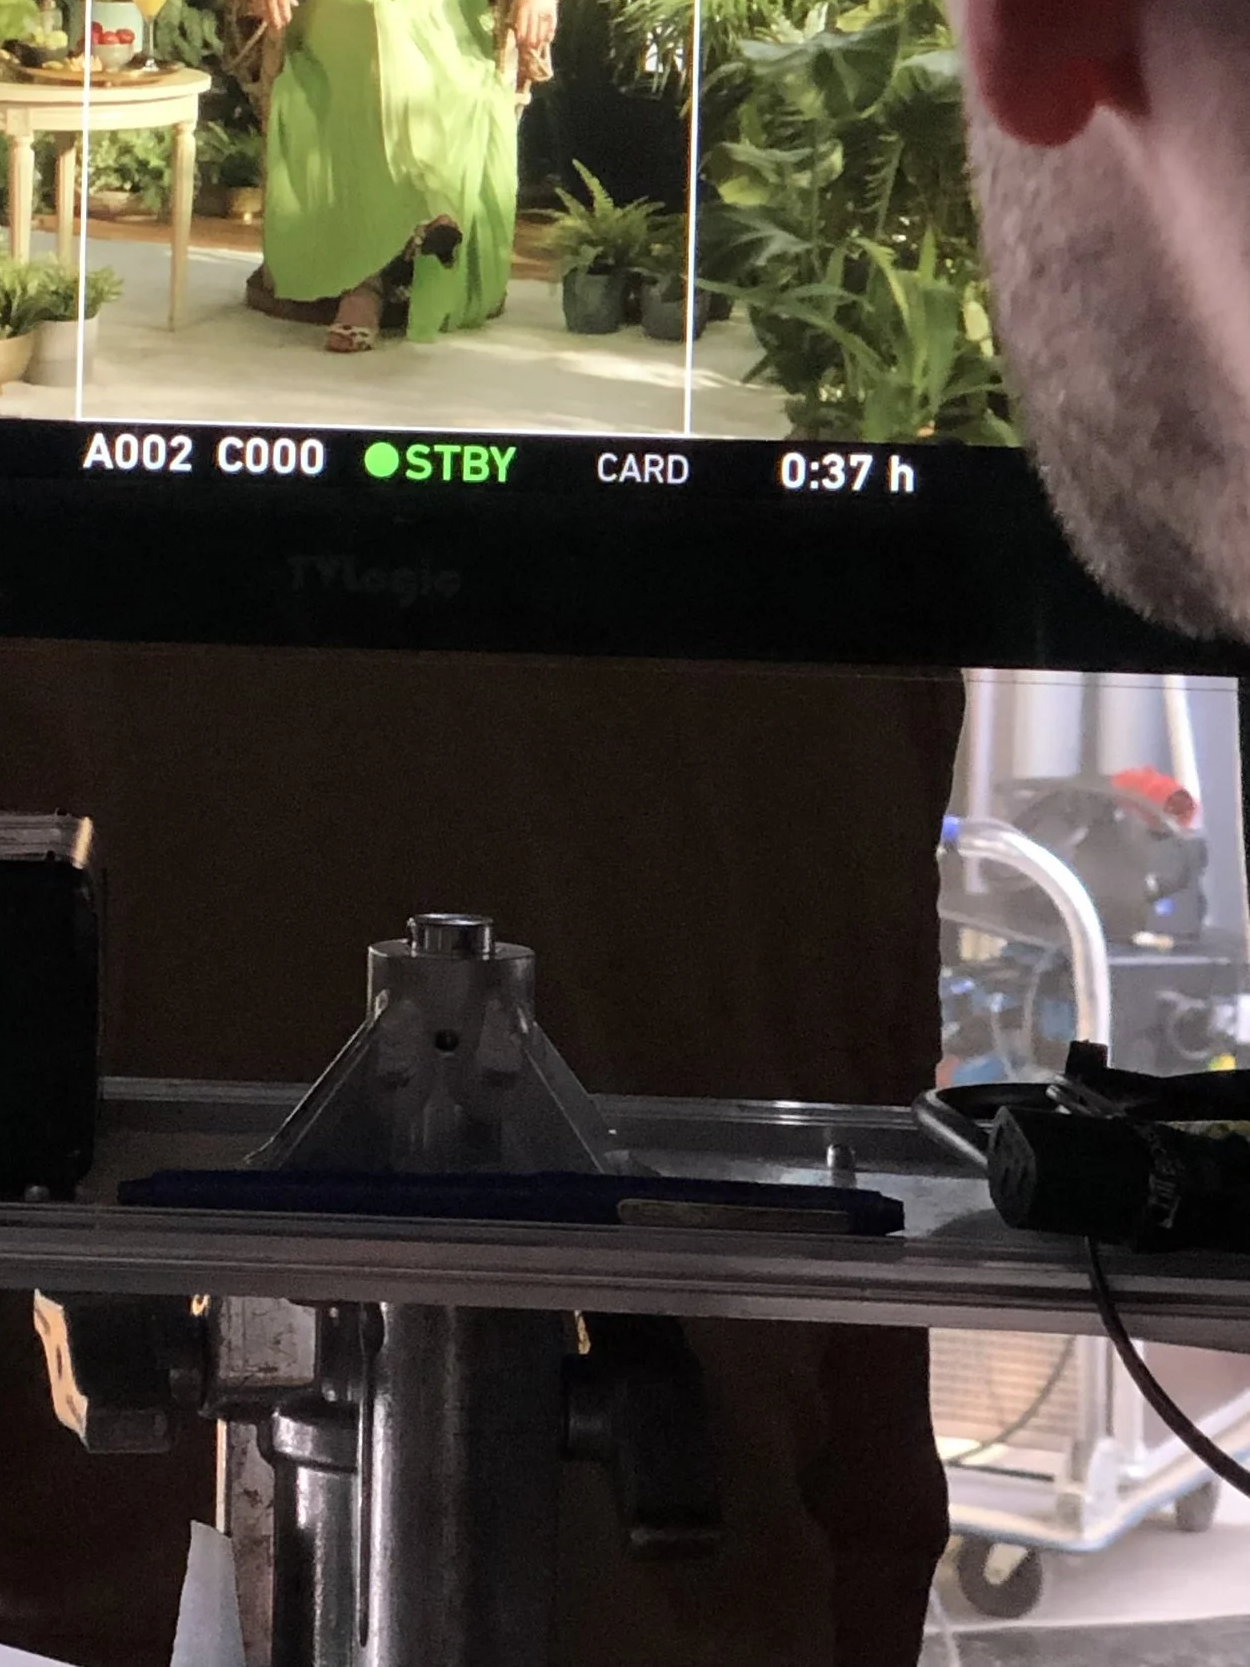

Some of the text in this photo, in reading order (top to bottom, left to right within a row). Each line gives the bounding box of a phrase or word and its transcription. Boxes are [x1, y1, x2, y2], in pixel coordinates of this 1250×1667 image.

[82, 431, 325, 476] A002 C000
[405, 443, 517, 483] STBY
[597, 452, 690, 484] CARD
[779, 451, 915, 493] 0:37 h
